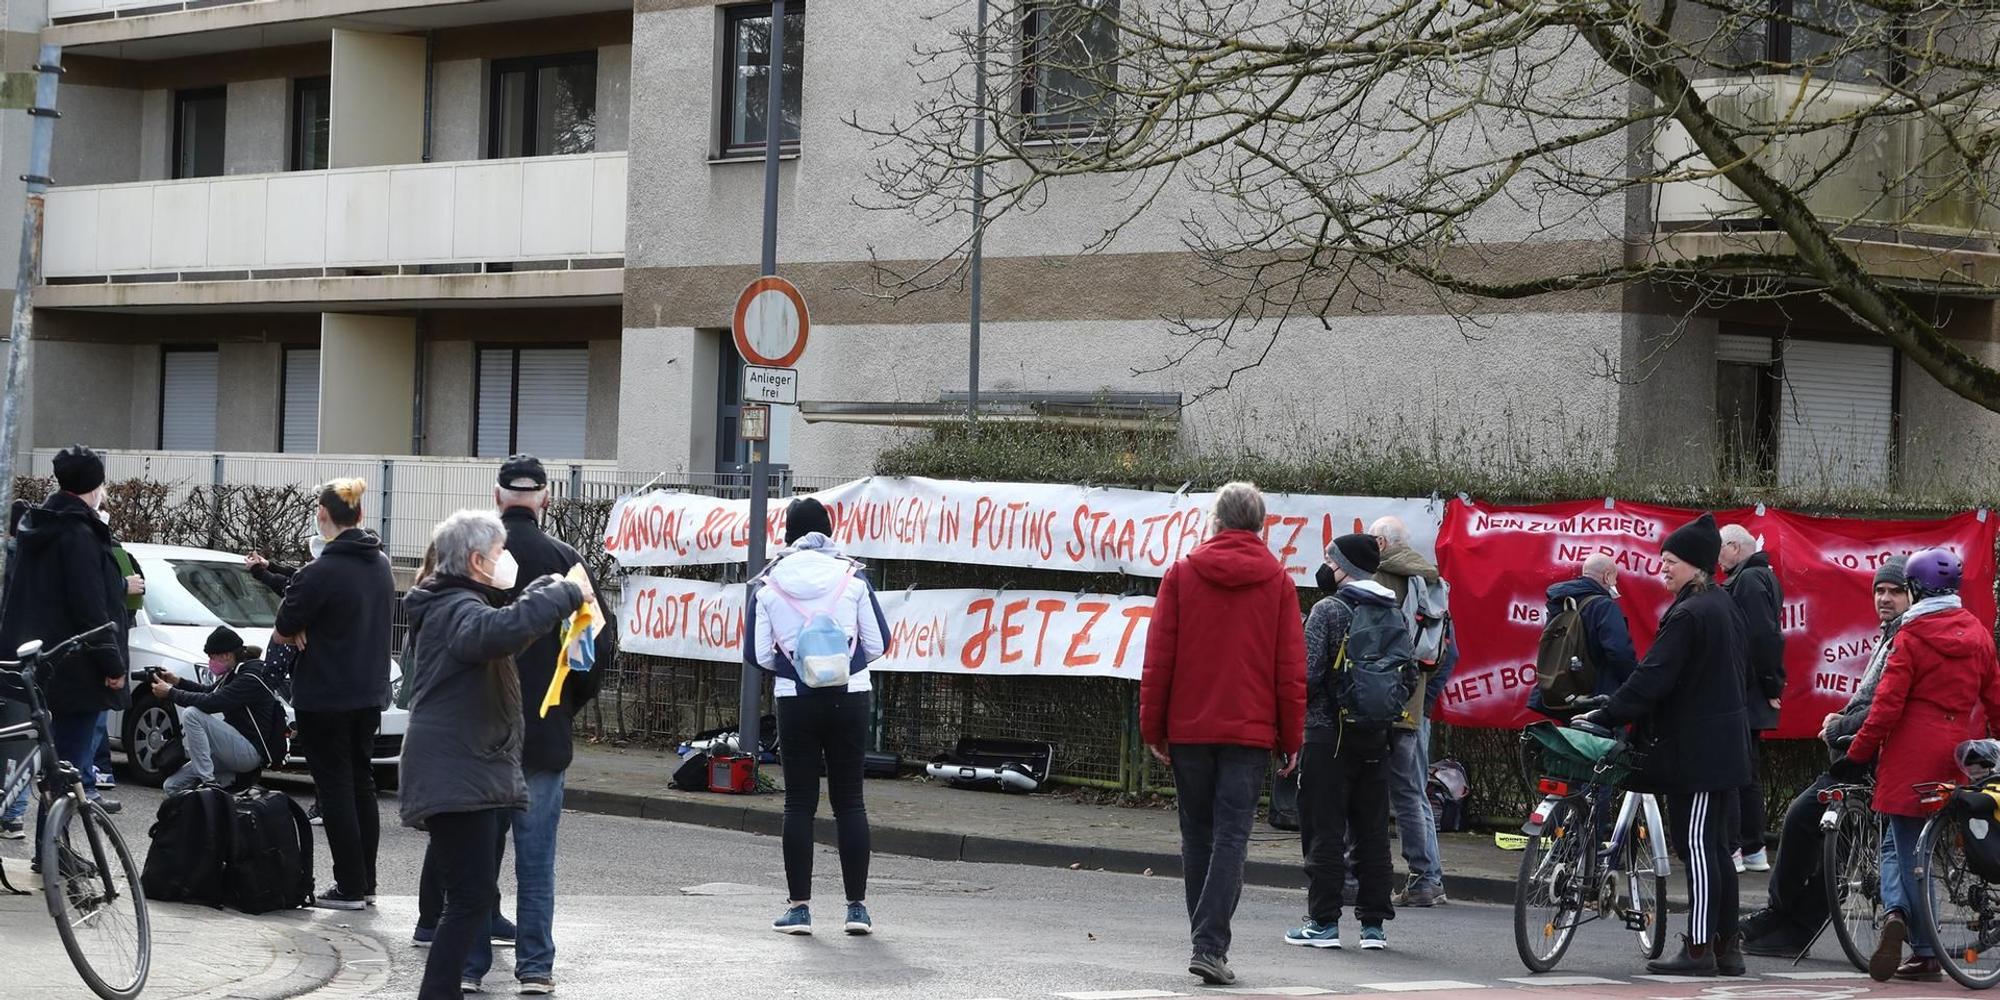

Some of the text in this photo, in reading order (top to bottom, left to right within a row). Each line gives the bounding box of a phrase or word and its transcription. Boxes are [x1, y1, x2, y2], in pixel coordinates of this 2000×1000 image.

[750, 372, 791, 387] Anlieger
[762, 386, 779, 398] frei
[696, 507, 737, 550] 80
[1476, 515, 1654, 538] NEIN ZUM KRIEG!
[1558, 543, 1593, 562] NE
[1512, 603, 1541, 621] Ne
[960, 597, 1154, 669] JETZT
[1816, 672, 1849, 692] NIE
